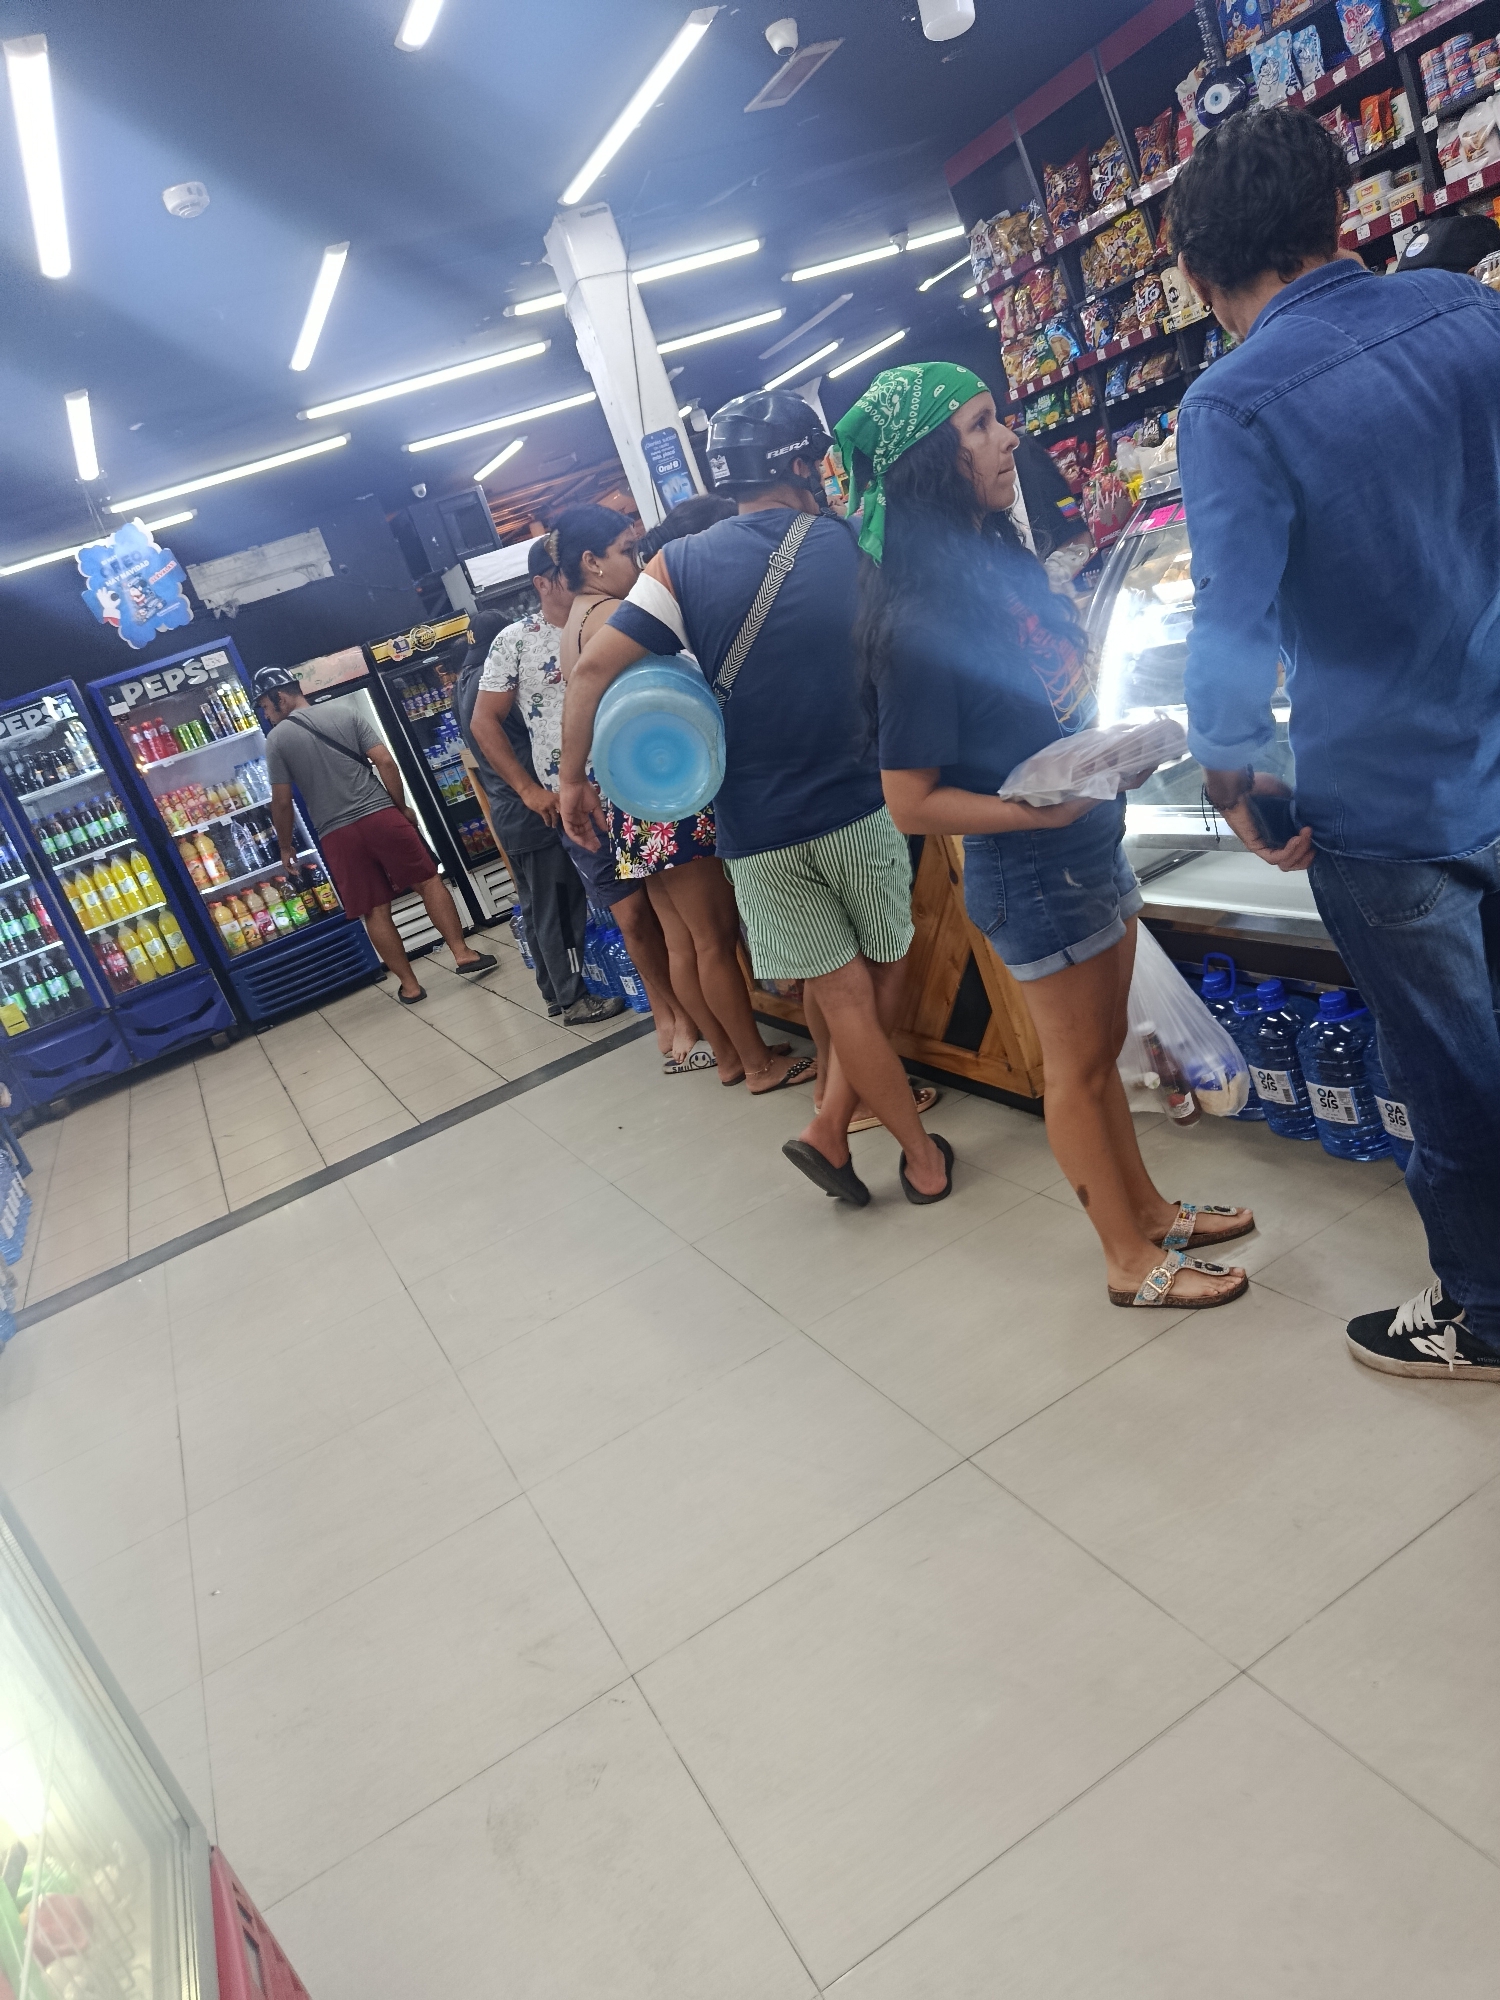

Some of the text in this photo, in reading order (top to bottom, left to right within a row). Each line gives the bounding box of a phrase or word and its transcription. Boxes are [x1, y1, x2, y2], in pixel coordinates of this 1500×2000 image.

[658, 460, 679, 473] Oral-B
[100, 550, 142, 578] OREO
[105, 575, 121, 587] HAY
[119, 560, 150, 579] NAVIDAD
